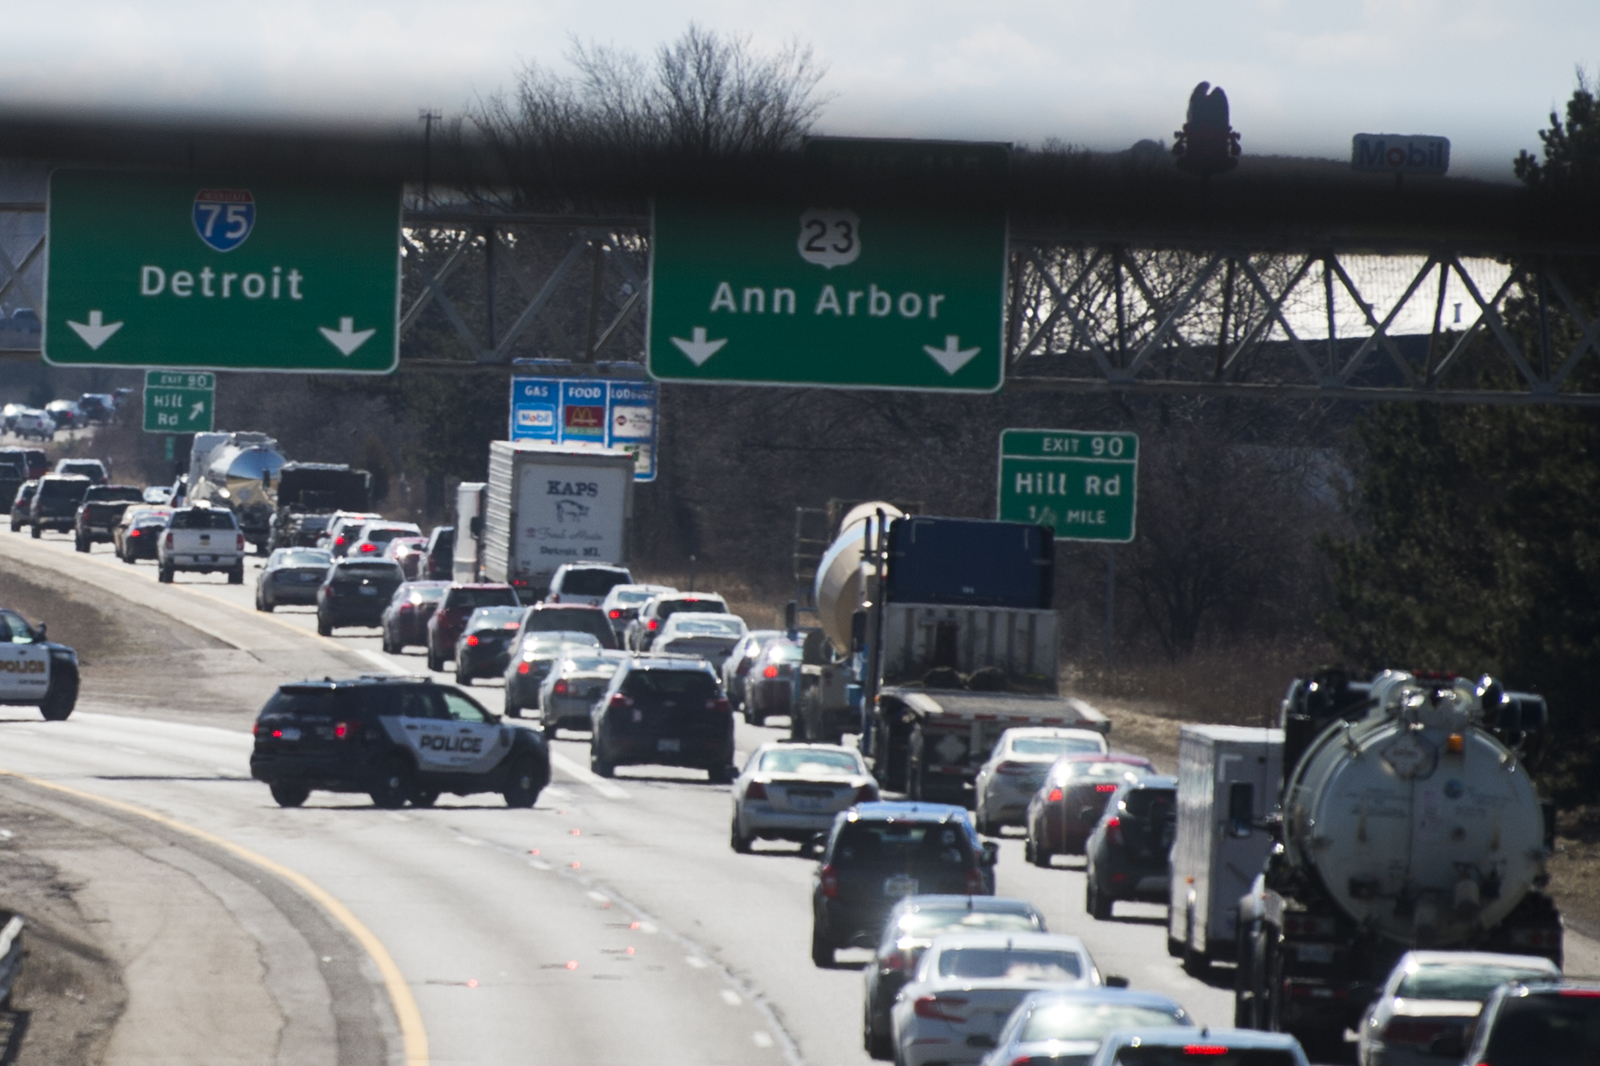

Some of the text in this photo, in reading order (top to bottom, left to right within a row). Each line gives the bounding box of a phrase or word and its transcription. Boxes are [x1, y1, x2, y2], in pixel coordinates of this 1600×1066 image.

[1358, 139, 1443, 166] Mobil
[199, 204, 248, 239] 75
[804, 219, 854, 254] 23
[141, 266, 303, 300] Detroit
[710, 282, 946, 319] Ann Arbor
[161, 375, 207, 388] EXIT 90
[524, 385, 549, 398] GAS
[568, 387, 602, 399] FOOD
[154, 394, 183, 408] Hill
[157, 413, 179, 426] Rd
[521, 412, 549, 428] Mobil
[1043, 437, 1123, 456] EXIT 90
[546, 480, 599, 498] KAPS
[1015, 472, 1120, 496] Hill Rd
[1067, 510, 1106, 524] MILE
[420, 734, 484, 754] POLICE
